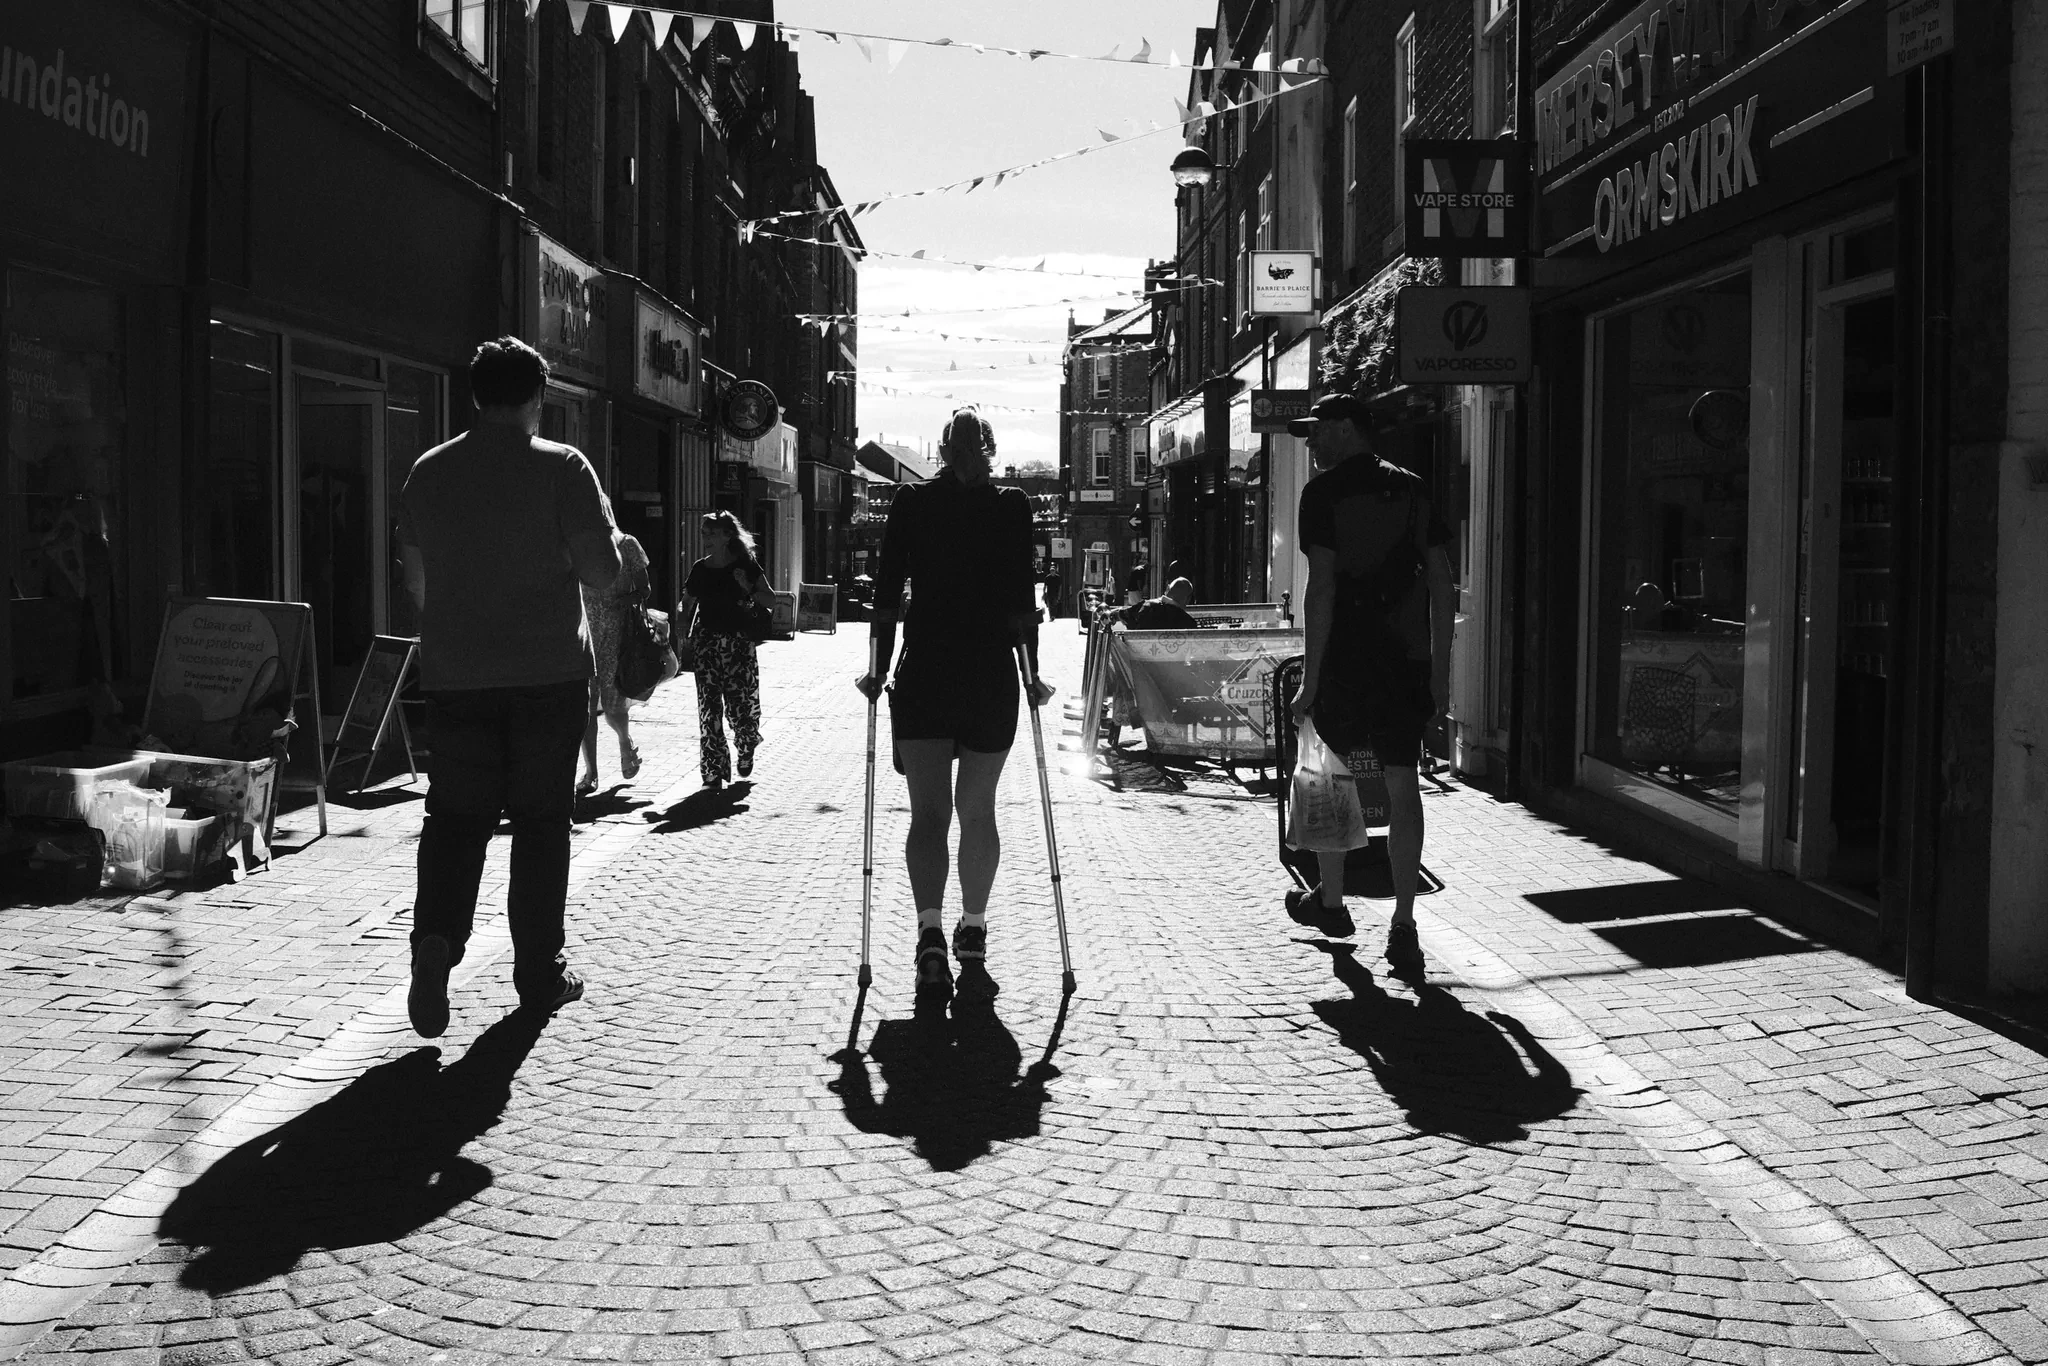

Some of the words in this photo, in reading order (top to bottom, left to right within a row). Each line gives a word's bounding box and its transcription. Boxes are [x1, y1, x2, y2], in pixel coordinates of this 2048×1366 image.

[1535, 9, 1660, 177] MERSEY
[1594, 93, 1760, 254] ORMSKIRK
[1413, 193, 1457, 208] VAPE
[1460, 193, 1515, 208] STORE
[1414, 357, 1517, 372] VAPORESSO
[1273, 405, 1309, 417] EATS
[192, 617, 227, 632] Clear
[228, 620, 252, 633] out
[174, 634, 203, 648] your
[204, 637, 265, 652] preloved
[176, 653, 254, 669] accessories
[217, 673, 230, 683] the
